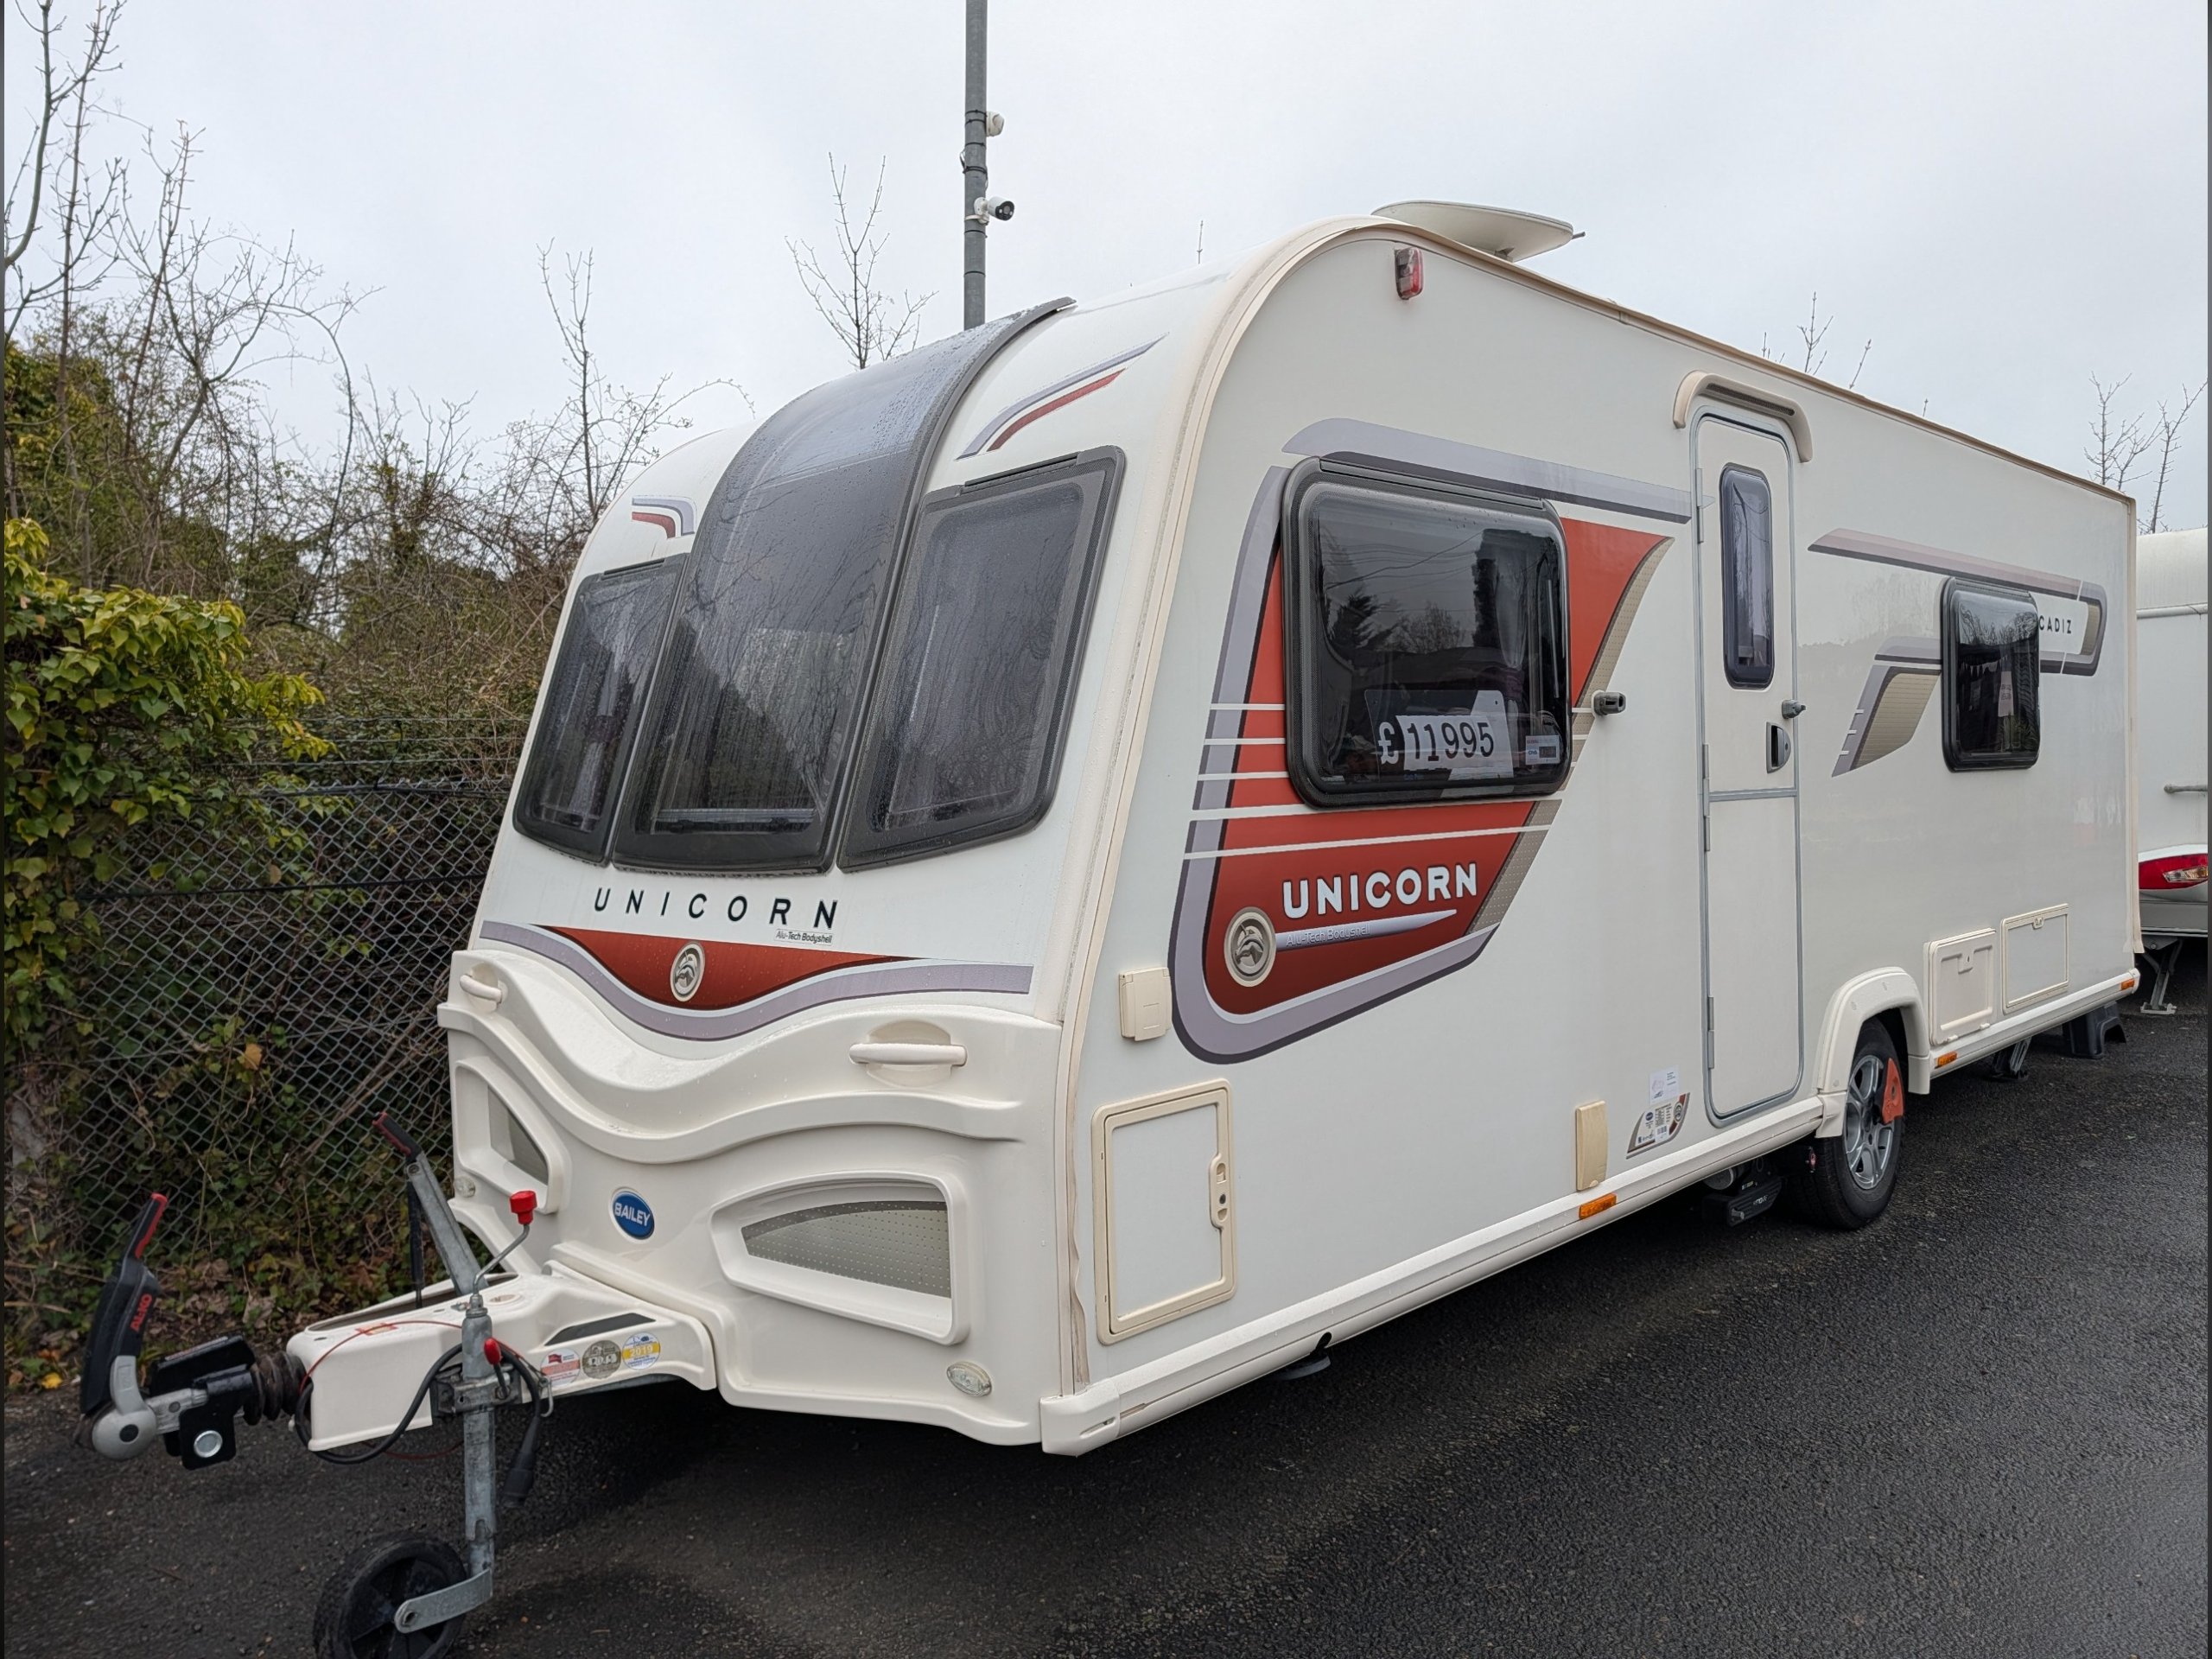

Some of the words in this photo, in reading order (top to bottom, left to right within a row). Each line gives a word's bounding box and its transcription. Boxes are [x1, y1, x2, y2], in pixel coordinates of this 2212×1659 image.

[2038, 615, 2072, 634] CADIZ
[1283, 863, 1478, 919] UNICORN
[594, 887, 838, 929] UNICORN
[776, 931, 801, 941] Alu-Tech
[802, 933, 833, 944] Bodyshell
[614, 1202, 650, 1227] BAILEY
[630, 1344, 653, 1357] 2019
